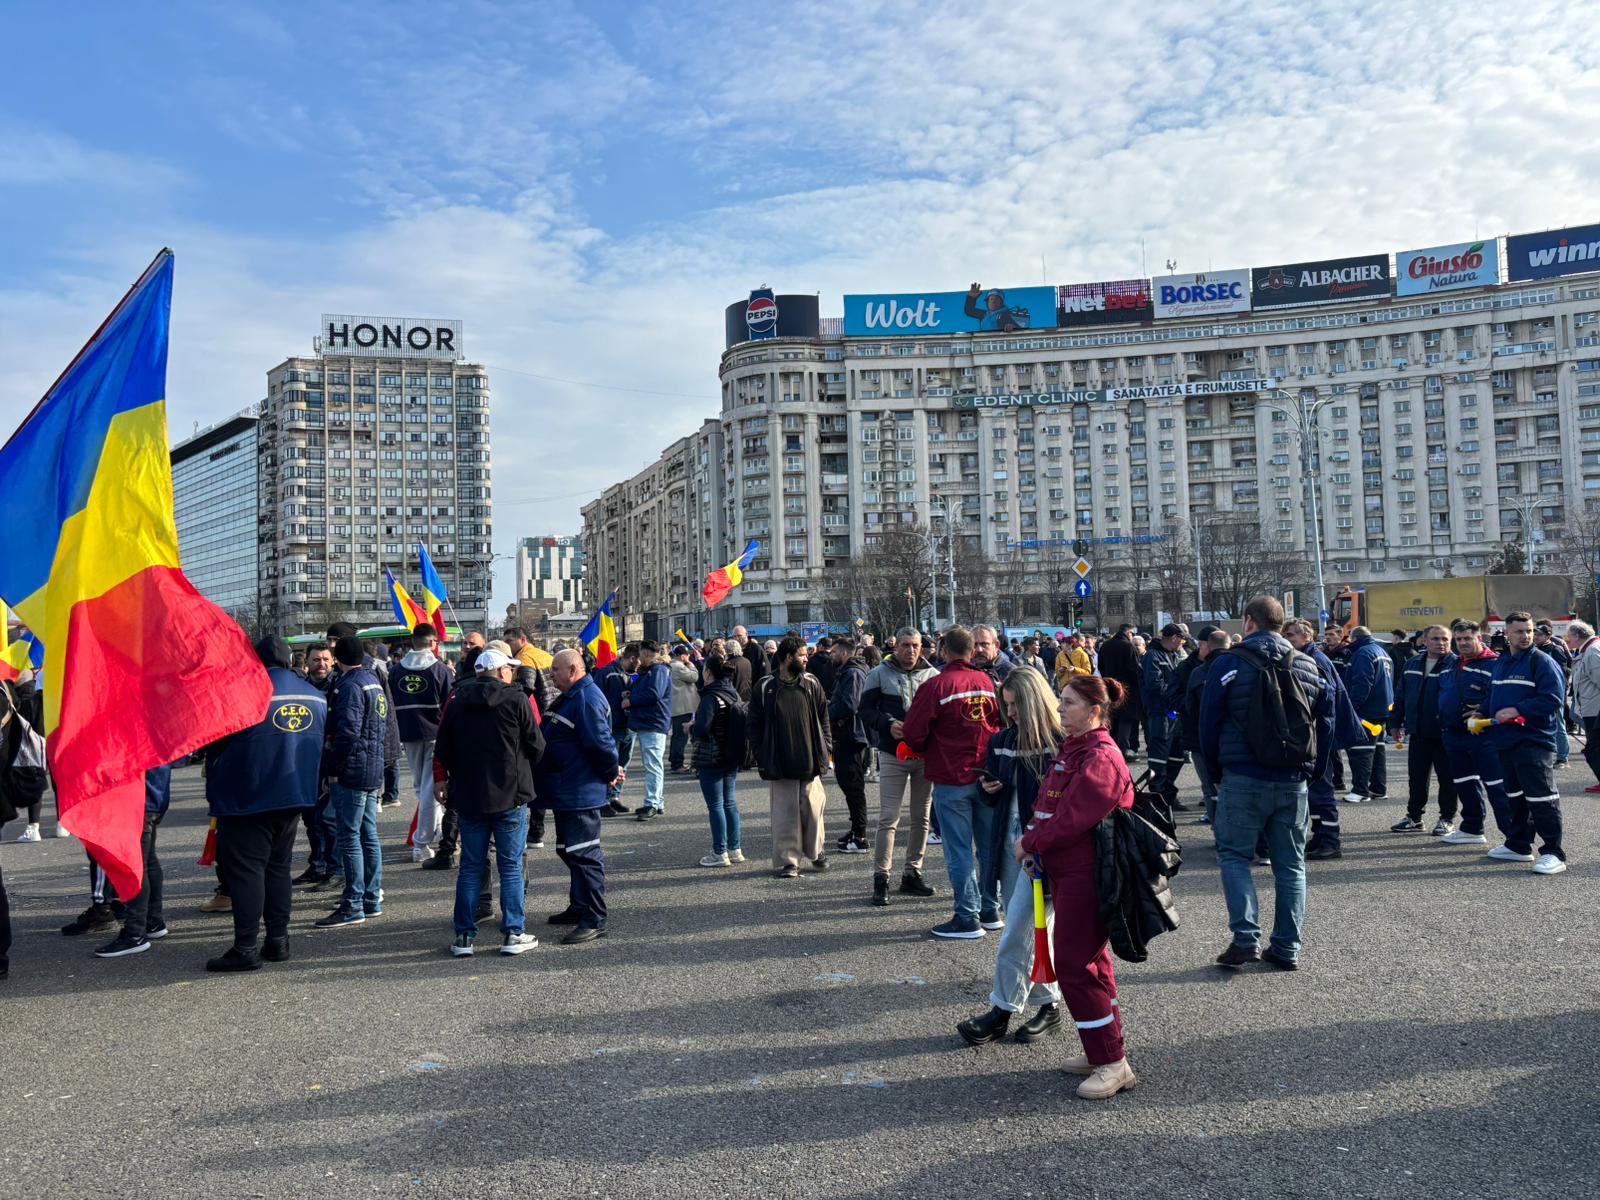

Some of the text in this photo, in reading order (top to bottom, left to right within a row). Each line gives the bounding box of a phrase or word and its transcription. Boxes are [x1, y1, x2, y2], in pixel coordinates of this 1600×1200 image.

[1299, 264, 1384, 287] ALBACHER
[1407, 250, 1483, 280] Giusto
[1428, 271, 1479, 289] Natura
[1064, 293, 1148, 313] NetBet
[1160, 281, 1242, 305] BORSEC
[747, 309, 776, 321] PEPSI
[865, 299, 941, 328] Wolt
[329, 322, 456, 351] HONOR
[1186, 384, 1193, 394] E
[1195, 379, 1268, 393] FRUMUSETE
[973, 391, 1097, 407] EDENT CLINIC
